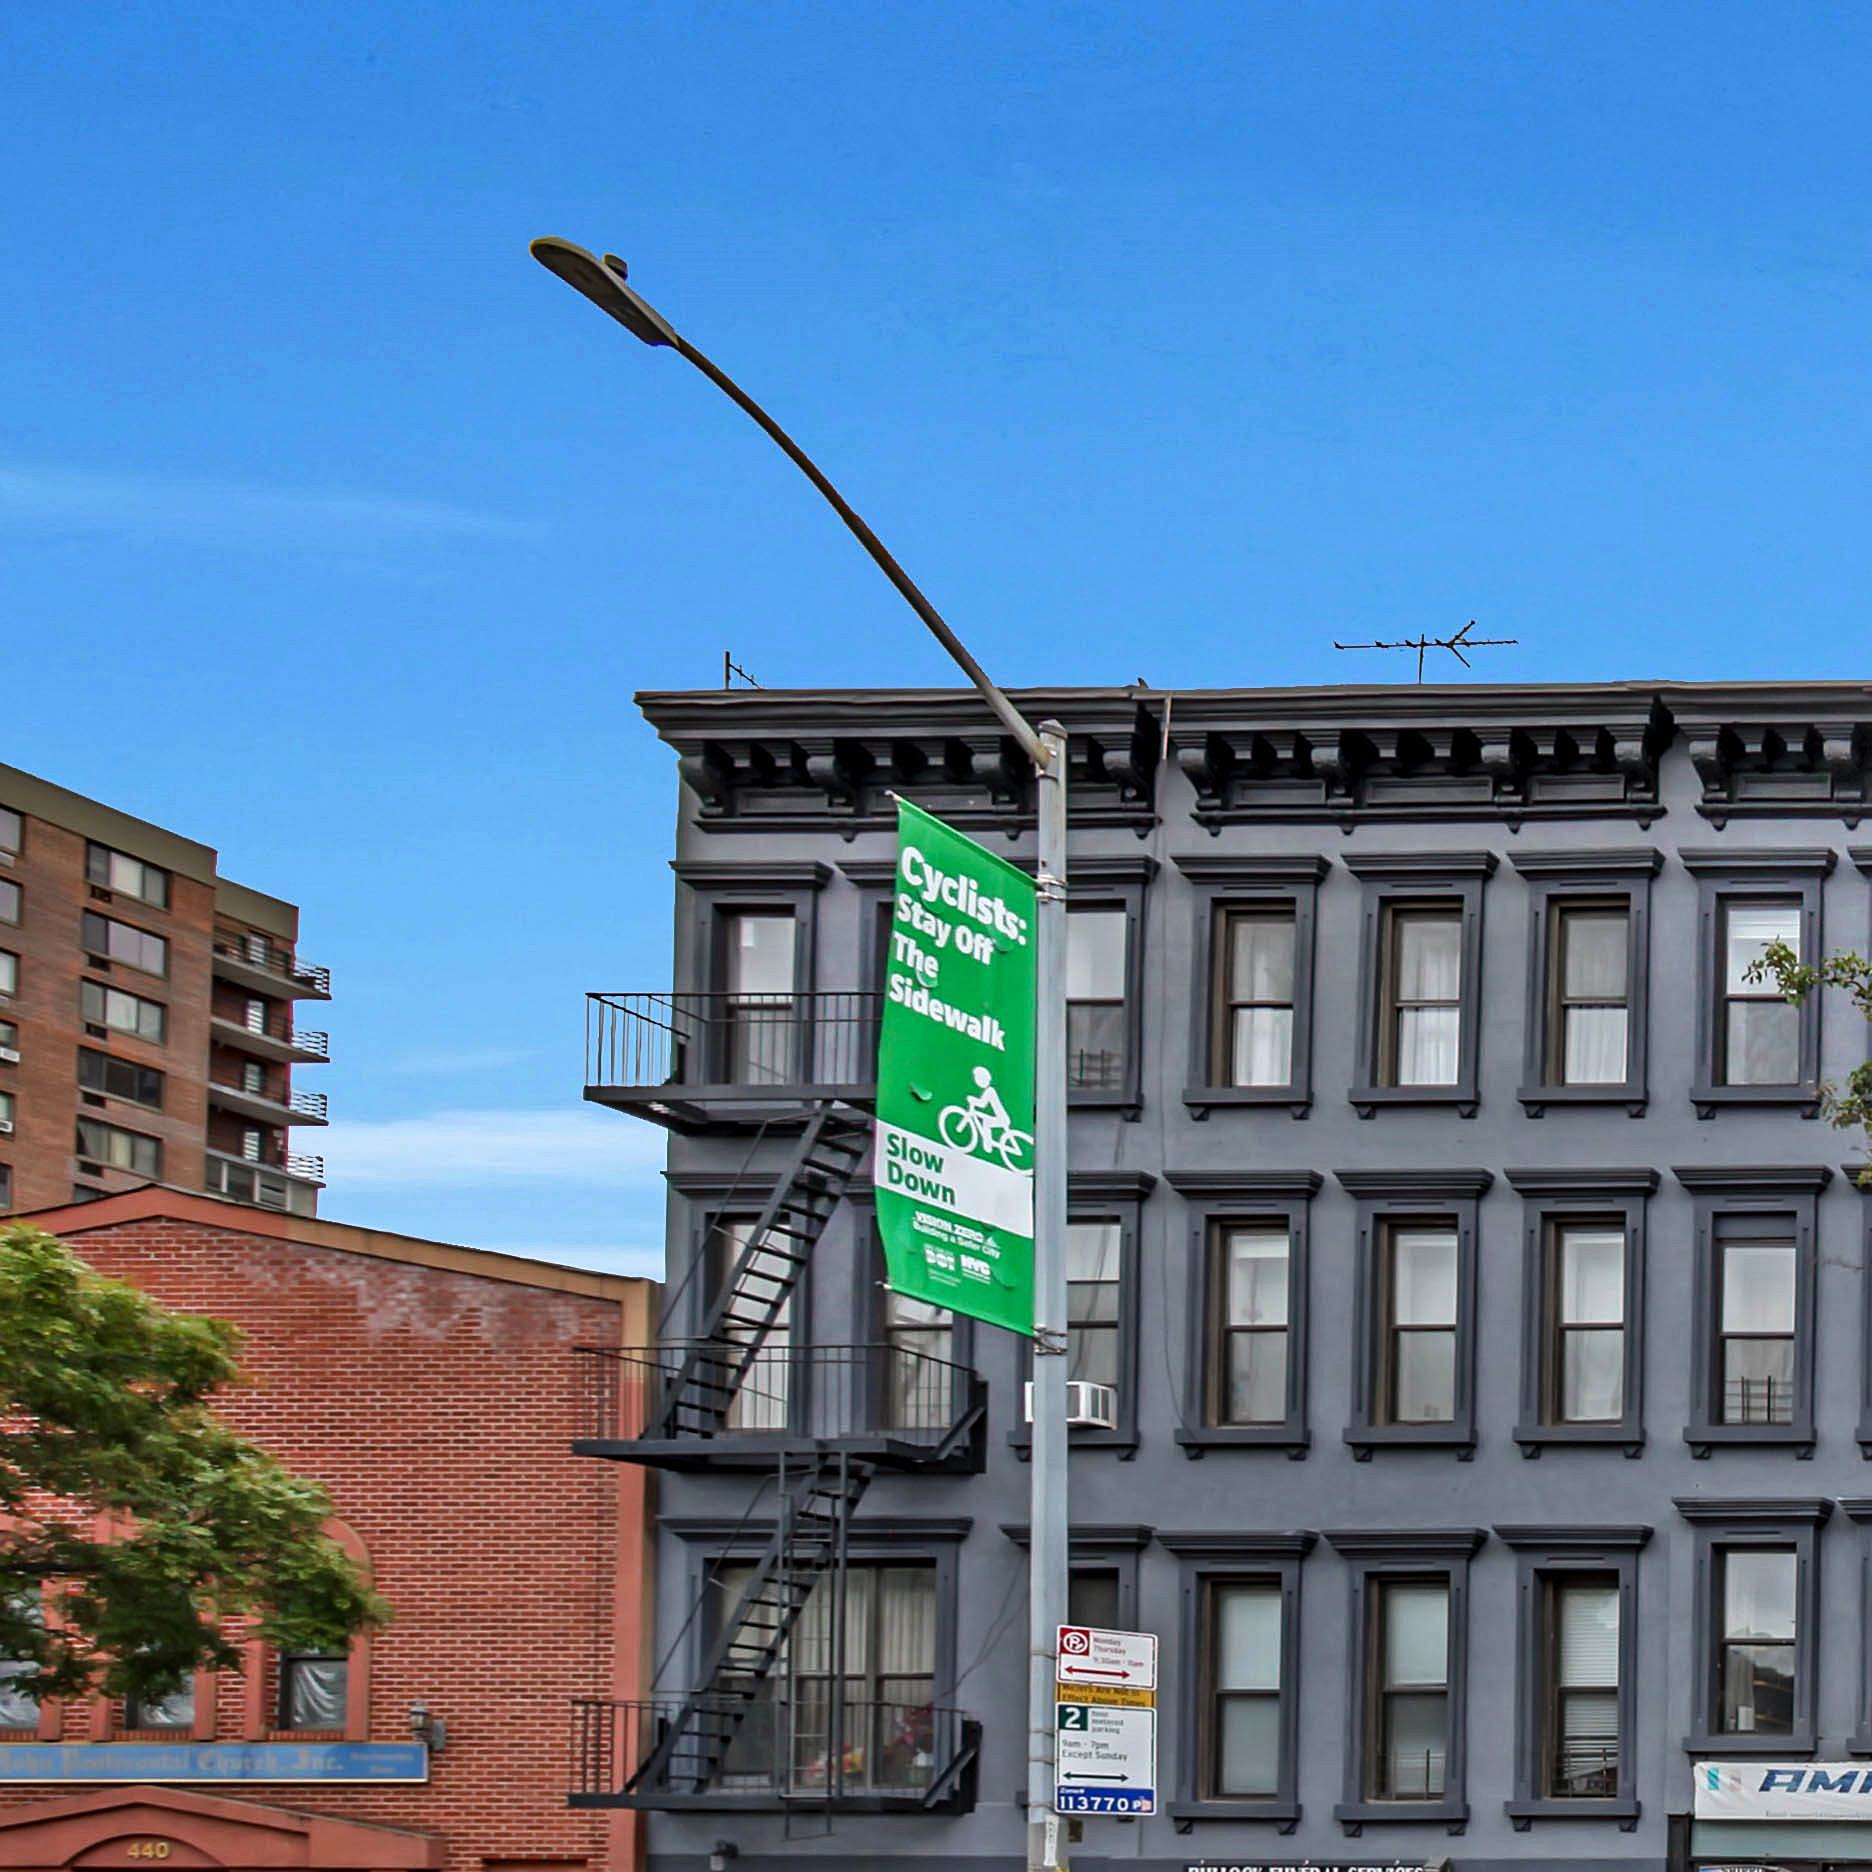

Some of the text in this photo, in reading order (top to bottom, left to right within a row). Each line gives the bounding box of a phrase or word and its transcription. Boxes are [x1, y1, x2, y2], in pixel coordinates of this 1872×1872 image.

[902, 846, 1027, 945] Cyclists:
[897, 893, 994, 966] Stay Off
[894, 930, 939, 979] The
[889, 974, 1006, 1052] Sidewalk
[887, 1133, 944, 1174] Slow
[887, 1160, 956, 1206] Down
[1064, 1707, 1082, 1729] 2
[1062, 1750, 1128, 1762] Except Sunday
[1060, 1796, 1129, 1811] 113770
[127, 1841, 170, 1859] 440
